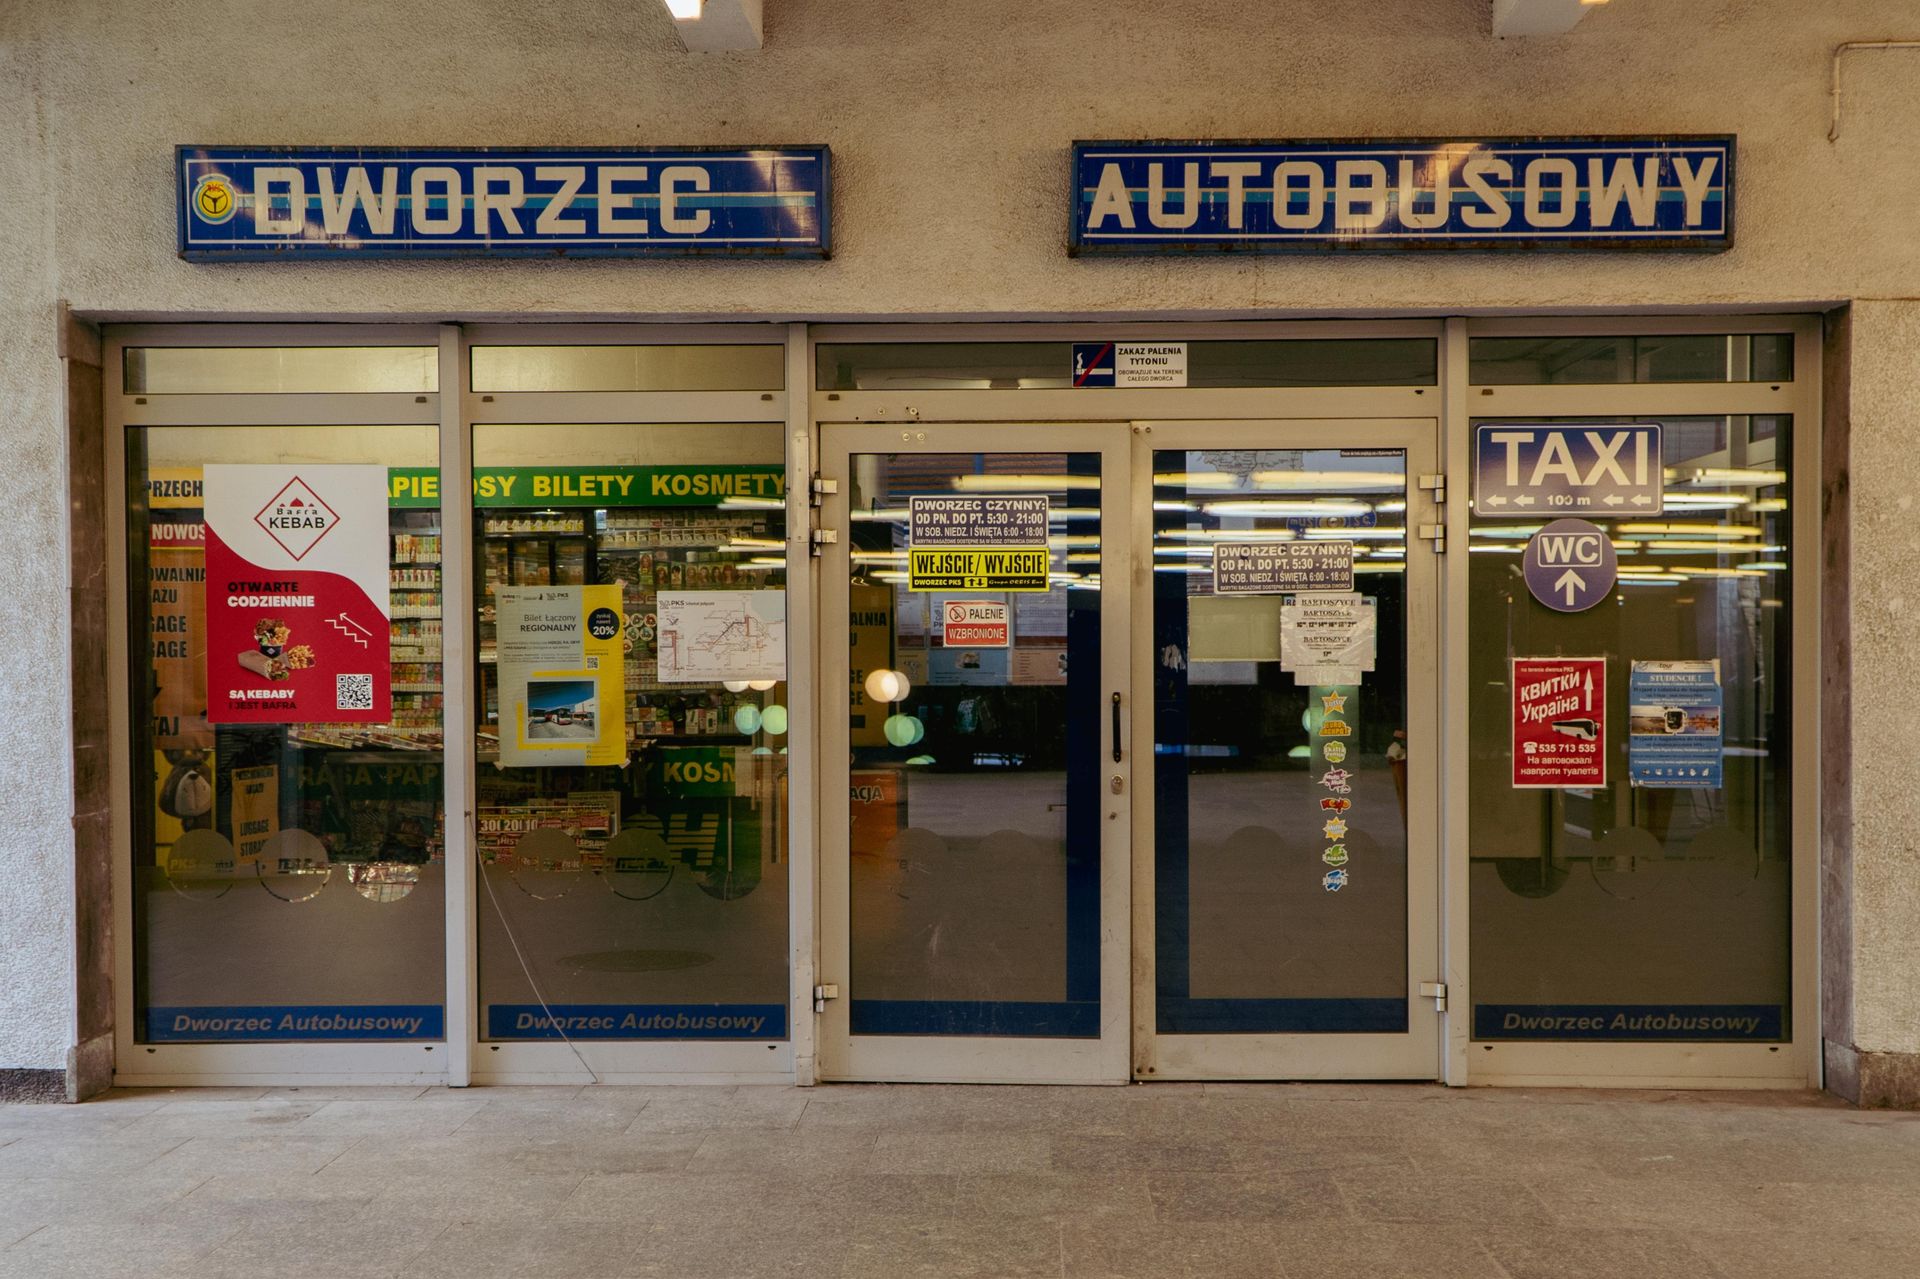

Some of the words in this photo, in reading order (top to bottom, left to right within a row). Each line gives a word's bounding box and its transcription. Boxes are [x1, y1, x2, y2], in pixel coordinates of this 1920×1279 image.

[1086, 157, 1720, 229] AUTOBUSOWY
[253, 165, 711, 236] DWORZEC
[1118, 347, 1145, 355] ZAKAZ
[1147, 347, 1182, 355] PALENIA
[1130, 357, 1168, 365] TYTONIU
[1491, 431, 1649, 486] TAXI
[388, 475, 439, 498] PIE
[533, 474, 634, 497] BILETY
[651, 474, 786, 497] KOSMETY
[914, 500, 982, 511] DWORZEC
[985, 500, 1046, 511] CZYNNY:
[1547, 494, 1573, 506] 100
[1576, 496, 1591, 506] m
[269, 516, 325, 529] KEBAB
[915, 513, 931, 525] OD
[933, 513, 950, 525] PN.
[952, 513, 967, 525] DO
[969, 513, 984, 525] PT.
[986, 513, 1008, 525] 5:30
[1015, 513, 1043, 525] 21:00
[915, 527, 925, 537] W
[924, 527, 943, 537] SOB.
[944, 527, 969, 537] NIEDZ.
[973, 525, 1002, 538] ŚWIĘTA
[1003, 527, 1019, 537] 6:00
[1024, 527, 1044, 537] 18:00
[1219, 546, 1287, 557] DWORZEC
[1290, 545, 1351, 556] CZYNNY:
[1541, 536, 1599, 564] WC
[916, 552, 974, 574] WEJŚCIE
[984, 552, 1043, 574] WYJŚCIE
[1220, 560, 1236, 571] OD
[1238, 560, 1255, 571] PN.
[1257, 559, 1272, 570] DO
[1274, 559, 1290, 570] PT.
[1291, 559, 1314, 569] 5:30
[1321, 558, 1349, 569] 21:00
[1220, 574, 1230, 583] W
[1229, 574, 1248, 583] SOB.
[1249, 573, 1274, 583] NIEDZ.
[1279, 571, 1308, 584] ŚWIĘTA
[1309, 572, 1325, 582] 6:00
[1330, 571, 1350, 581] 18:00
[227, 581, 299, 593] OTWARTE
[227, 595, 315, 608] CODZIENNIE
[523, 614, 542, 622] Bilet
[544, 614, 577, 623] Łączony
[969, 608, 1004, 620] PALENIE
[520, 623, 577, 632] REGIONALNY
[592, 626, 615, 636] 20%
[948, 628, 1005, 640] WZBRONIONE
[1521, 671, 1580, 703] КВИТКИ
[229, 689, 246, 701] SĄ
[246, 689, 295, 699] KEBABY
[234, 702, 259, 710] JEST
[261, 701, 297, 710] BAFRA
[1521, 695, 1579, 724] Україна
[1538, 743, 1557, 753] 535
[1558, 743, 1576, 753] 713
[1578, 743, 1597, 753] 535
[1527, 756, 1540, 764] На
[1541, 755, 1592, 764] автовокзалі
[1520, 767, 1561, 776] навпроти
[1563, 766, 1599, 777] туалетів
[173, 1014, 273, 1032] Dworzec
[277, 1013, 424, 1034] Autobusowy
[516, 1012, 615, 1030] Dworzec
[619, 1012, 766, 1033] Autobusowy
[1503, 1013, 1604, 1030] Dworzec
[1610, 1013, 1760, 1033] Autobusowy
